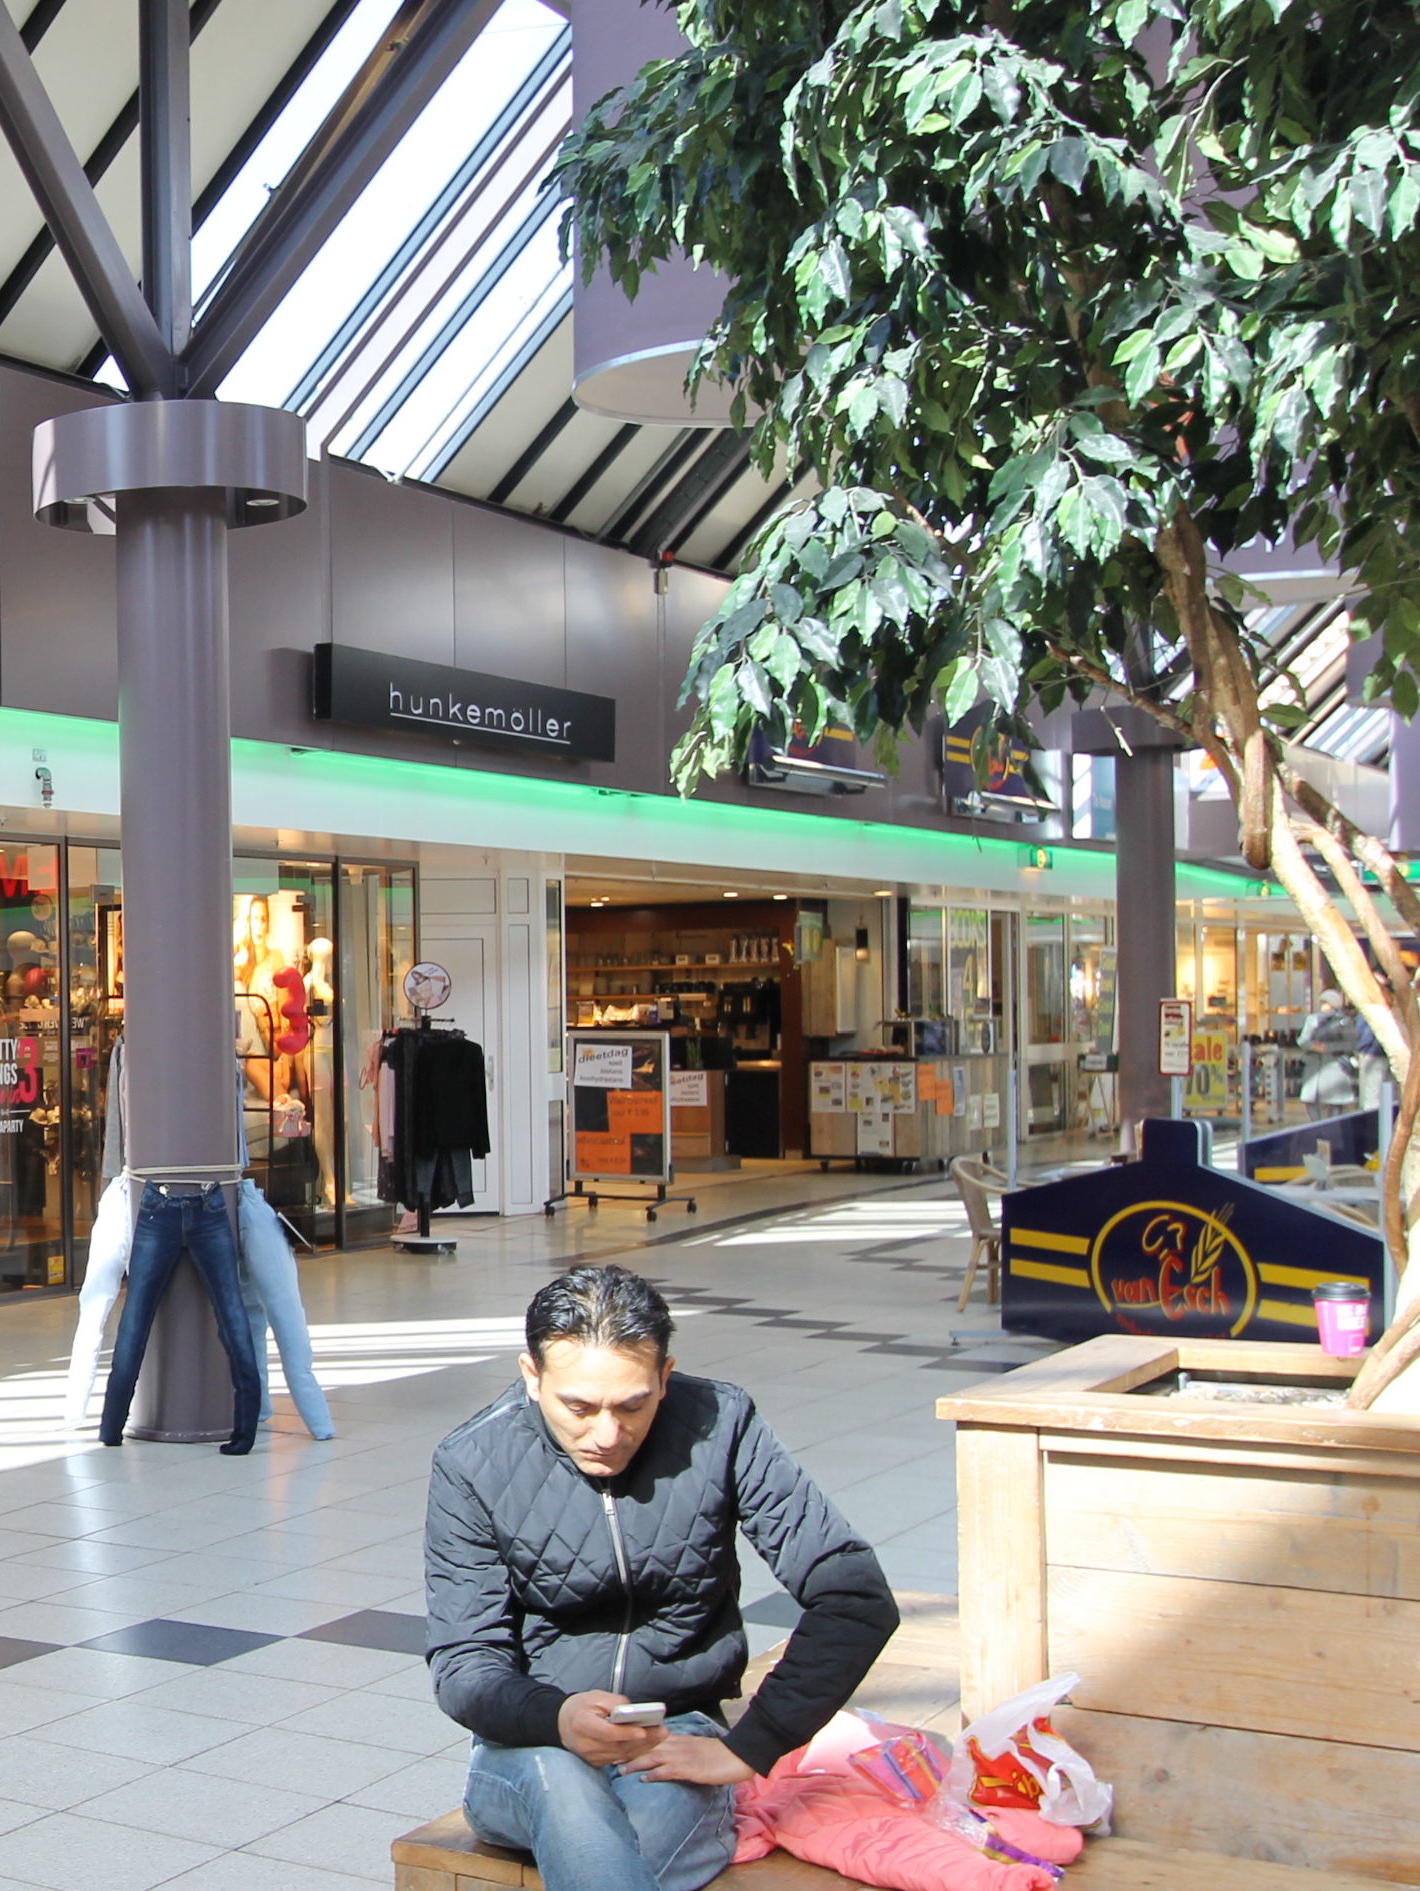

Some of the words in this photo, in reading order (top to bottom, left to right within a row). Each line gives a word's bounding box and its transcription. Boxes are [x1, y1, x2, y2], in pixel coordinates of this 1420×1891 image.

[390, 682, 572, 738] hunkemöller
[1111, 1277, 1158, 1303] van
[1159, 1256, 1232, 1321] Esch
